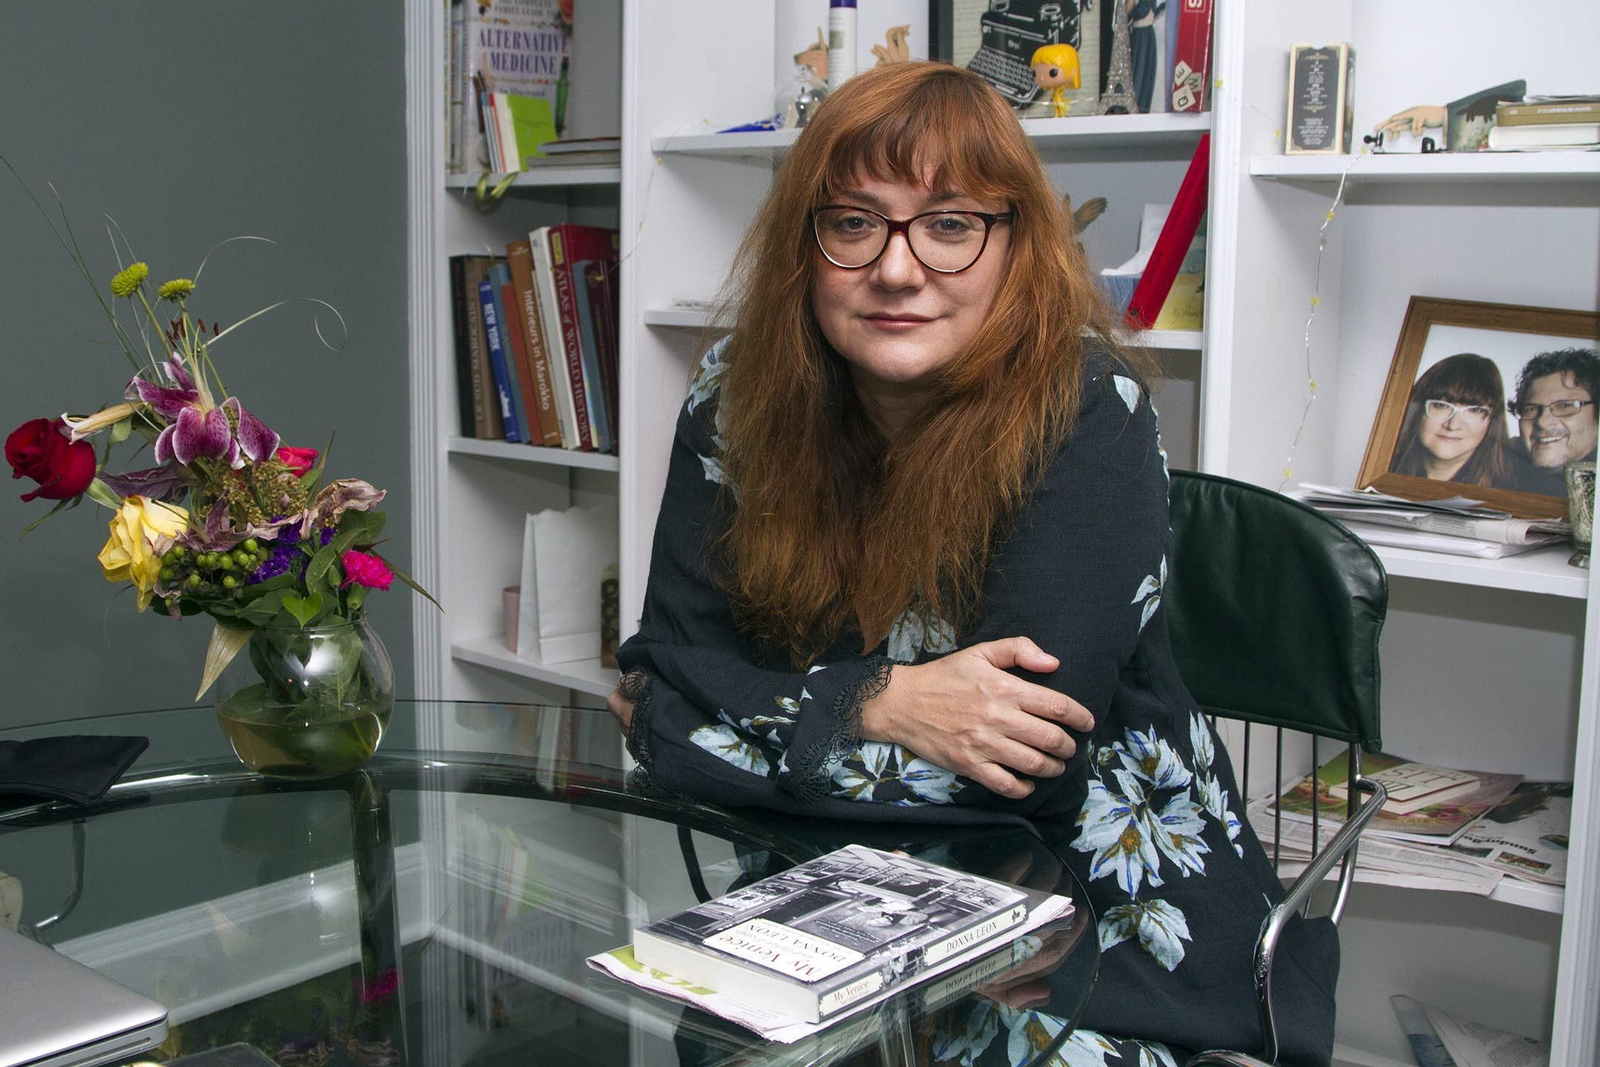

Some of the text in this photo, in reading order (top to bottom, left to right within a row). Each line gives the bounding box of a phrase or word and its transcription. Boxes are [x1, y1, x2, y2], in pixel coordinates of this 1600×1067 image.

[479, 28, 569, 53] ALTERNATIVE
[490, 51, 557, 75] MEDICINE
[1176, 68, 1185, 79] E
[1178, 95, 1189, 107] Q
[483, 303, 497, 326] NEW
[523, 289, 538, 347] Interieurs
[486, 325, 501, 351] YORK
[532, 348, 541, 358] in
[555, 268, 571, 314] ATLAS
[566, 327, 580, 381] WORLD
[573, 381, 590, 443] HISTORY
[534, 359, 552, 412] Marokko
[745, 924, 789, 945] LEON
[946, 920, 998, 951] DONNA LEON
[719, 936, 781, 965] Venice
[792, 939, 846, 963] DONNA
[788, 960, 820, 976] My
[833, 991, 845, 1004] My
[845, 980, 870, 999] Venice
